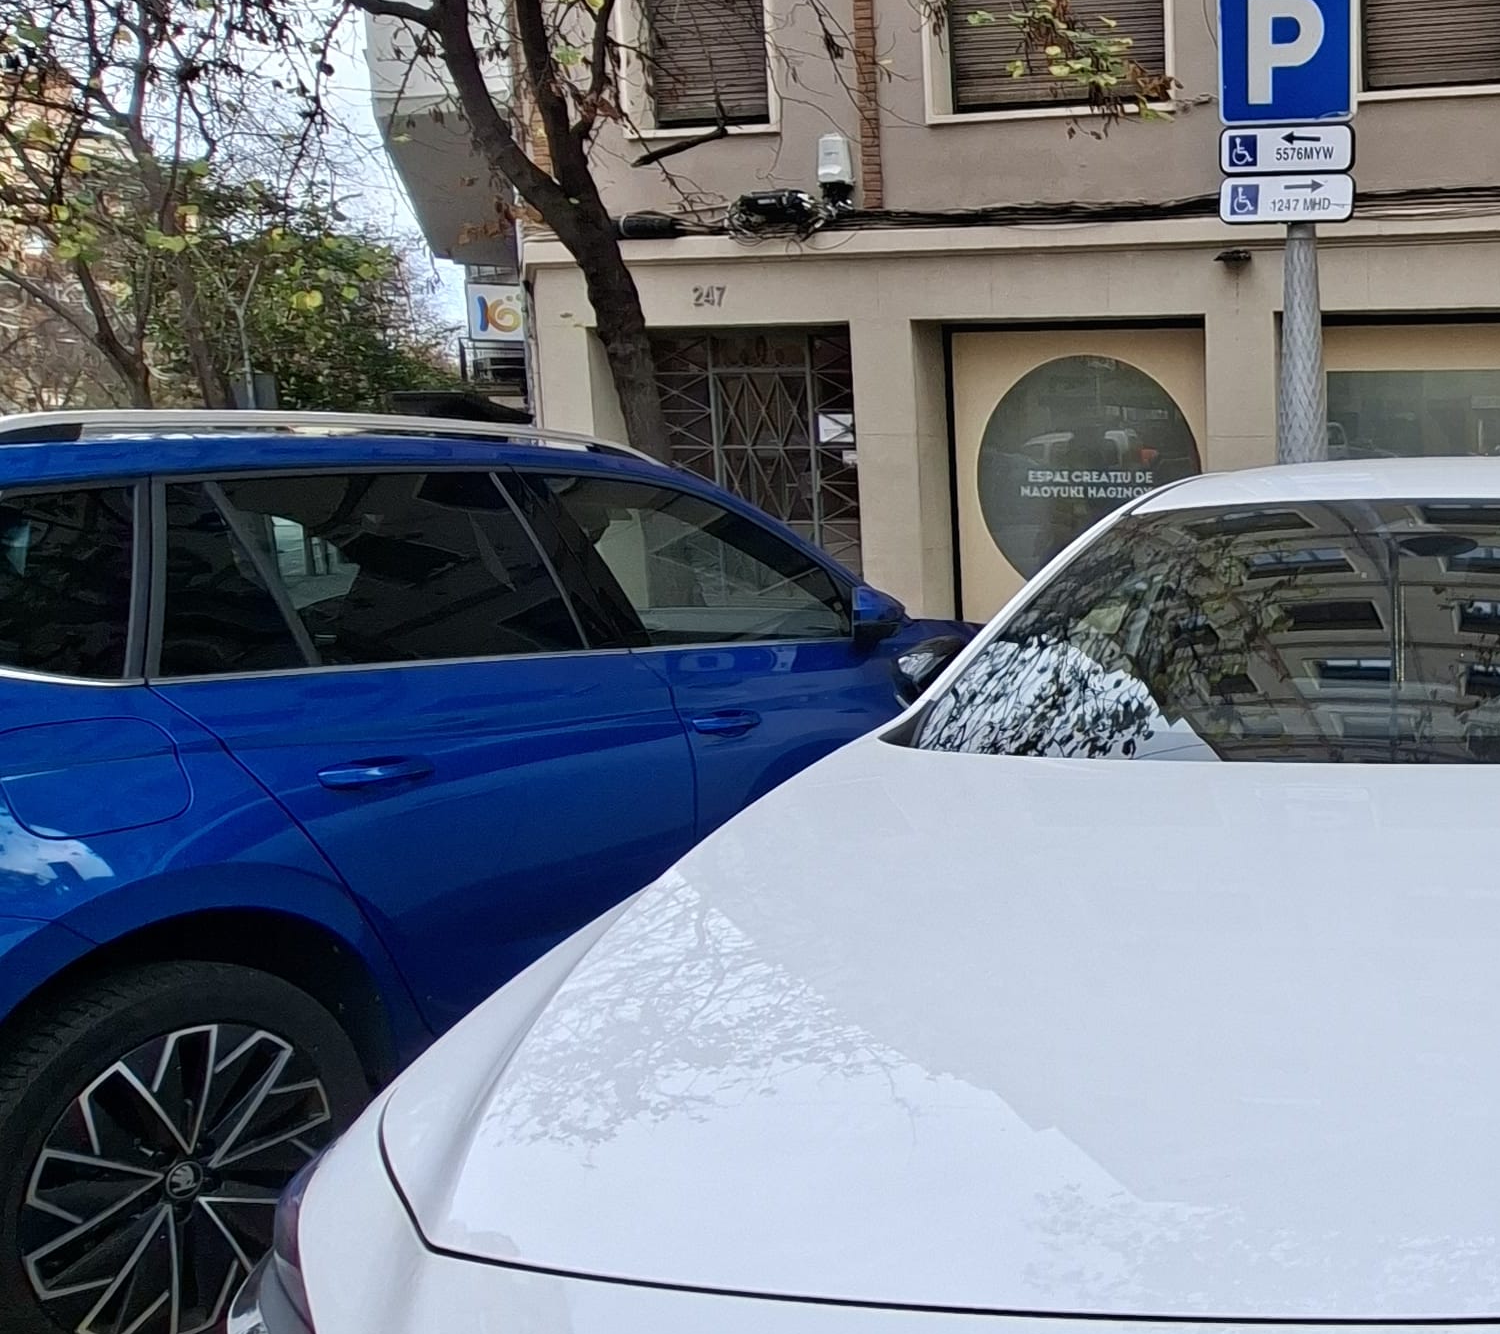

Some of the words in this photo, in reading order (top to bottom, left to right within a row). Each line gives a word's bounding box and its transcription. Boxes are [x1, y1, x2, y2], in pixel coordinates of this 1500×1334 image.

[1275, 146, 1334, 161] 5576MYW
[1271, 198, 1300, 212] 1247
[692, 285, 727, 307] 247
[1028, 470, 1069, 483] ESPAI
[1071, 470, 1131, 483] CREATIU
[1135, 471, 1153, 483] DE
[1021, 486, 1085, 498] NAOYUKI
